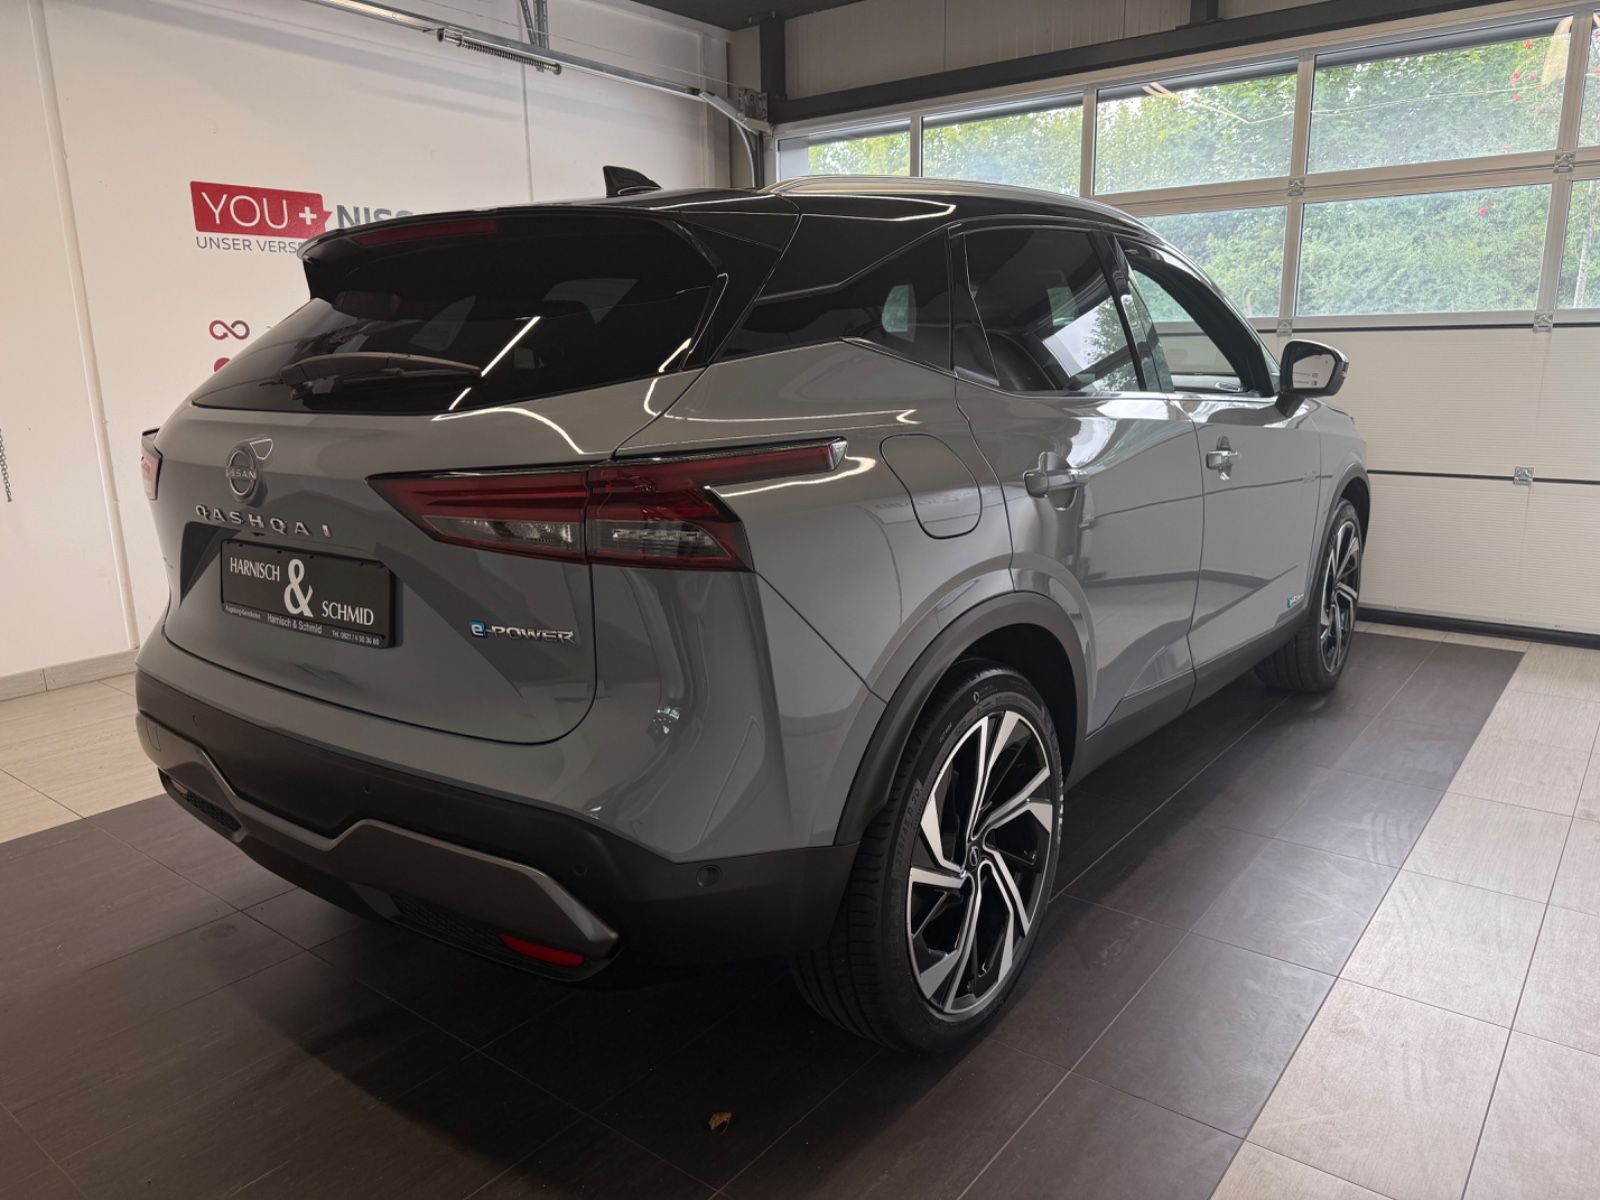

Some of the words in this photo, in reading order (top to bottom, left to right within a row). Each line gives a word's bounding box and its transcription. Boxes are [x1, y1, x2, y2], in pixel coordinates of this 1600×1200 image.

[336, 204, 415, 231] NIS
[196, 236, 252, 251] UNSER
[195, 504, 332, 538] QASHQAI
[230, 557, 280, 582] HARNISCH
[284, 559, 314, 618] &
[267, 613, 292, 628] Harnisch
[298, 620, 323, 635] Schmid
[322, 600, 374, 626] SCHMID
[470, 621, 576, 645] e-POWER
